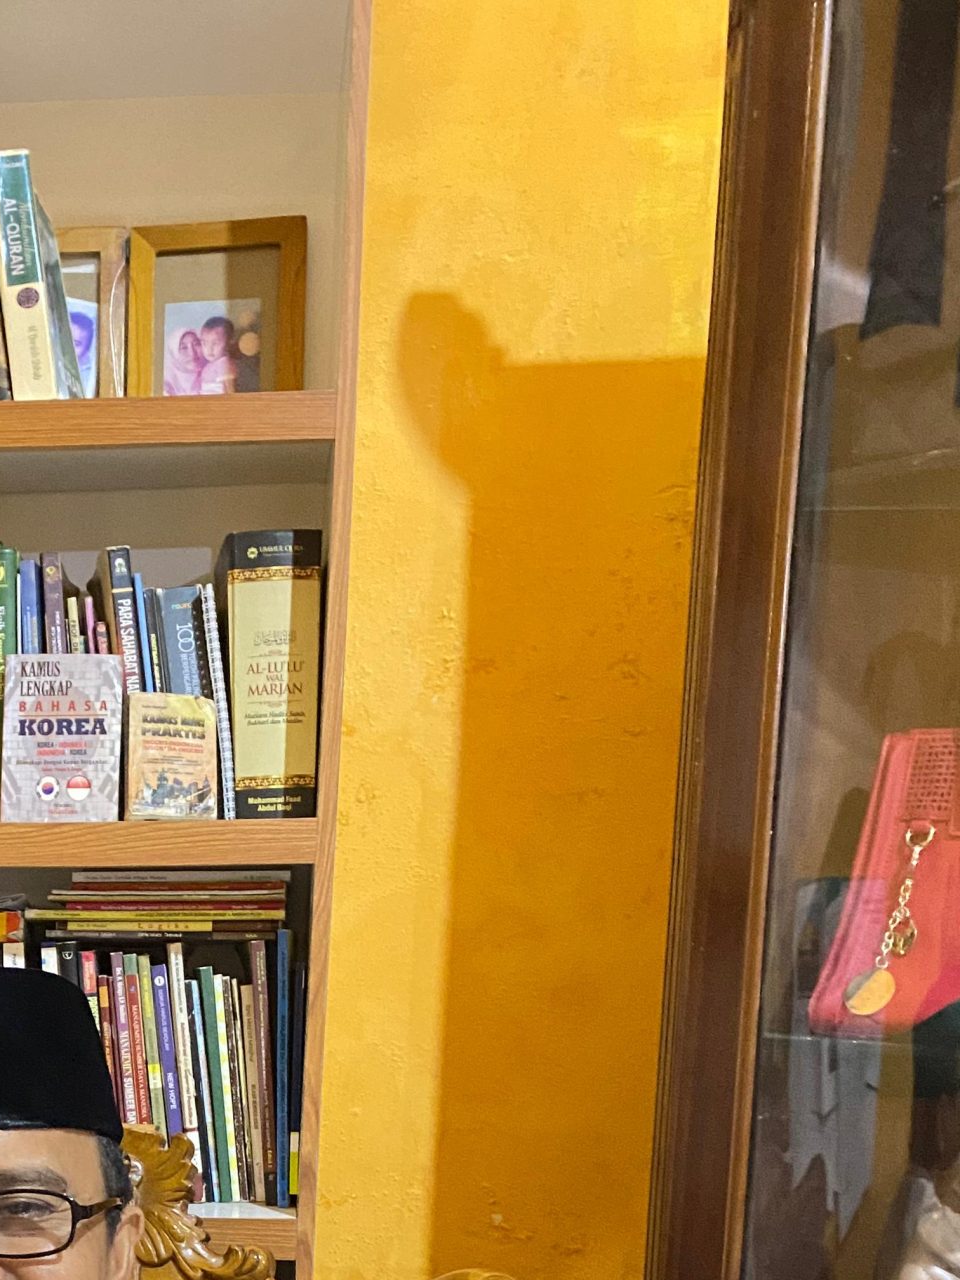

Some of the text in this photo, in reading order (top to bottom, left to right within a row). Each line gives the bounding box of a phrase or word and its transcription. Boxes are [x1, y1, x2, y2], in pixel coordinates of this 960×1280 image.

[2, 196, 25, 277] AL-QURAN
[117, 598, 139, 674] PARA SAHABAT
[176, 622, 196, 652] 100
[20, 660, 61, 678] KAMUS
[265, 674, 285, 682] WAL
[20, 680, 73, 697] LENGKAP
[247, 681, 304, 698] MARJAN
[19, 701, 108, 712] BAHASA
[18, 717, 107, 736] KOREA
[141, 726, 206, 740] PRAKTIS
[247, 794, 285, 804] Muhammad
[131, 1004, 148, 1118] MANAJEMEN SUMBER DAYA MANUSIA
[119, 1030, 137, 1125] MANAJEMEN SUMBER DAY
[166, 1072, 178, 1111] NEW HOPE
